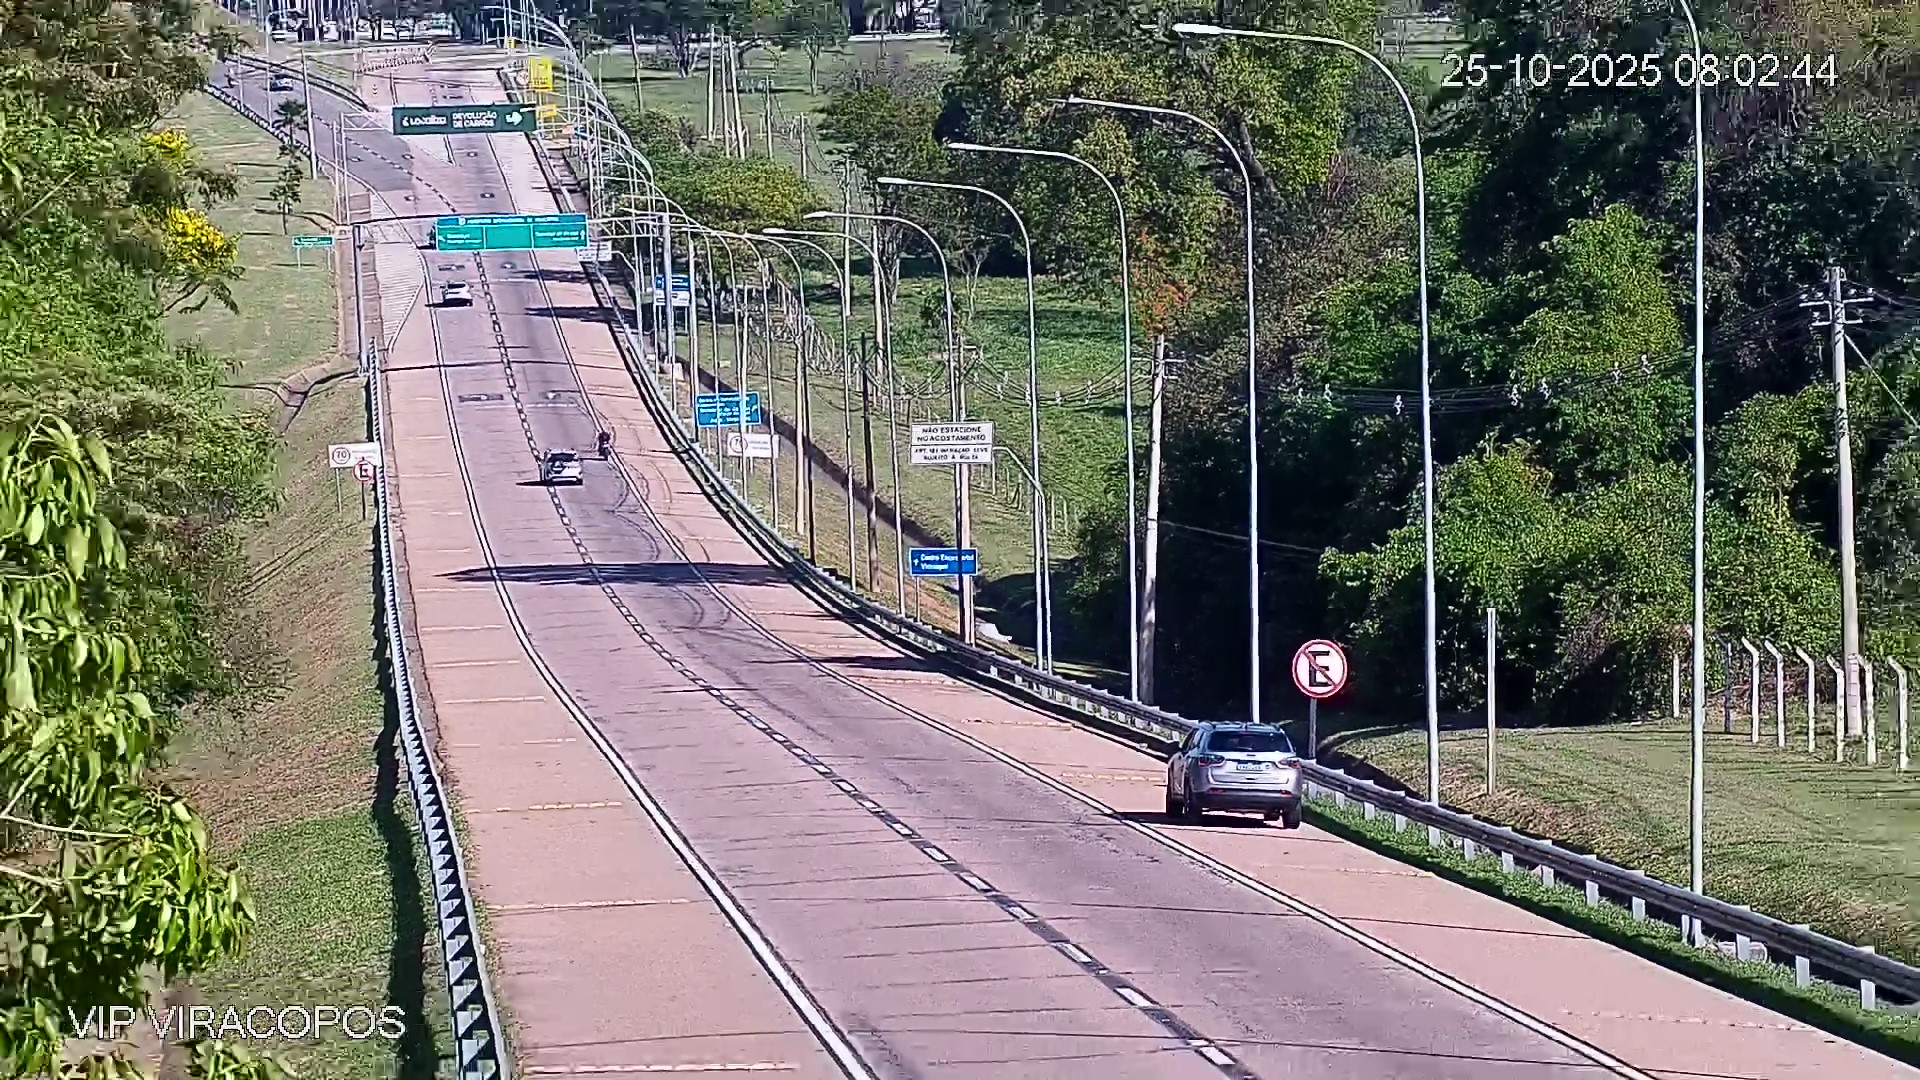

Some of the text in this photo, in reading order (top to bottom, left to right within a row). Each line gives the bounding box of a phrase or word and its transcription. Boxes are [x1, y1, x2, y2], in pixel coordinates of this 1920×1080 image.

[453, 120, 463, 128] DE
[929, 434, 986, 442] ACOSTAMENTO
[1308, 650, 1332, 687] E
